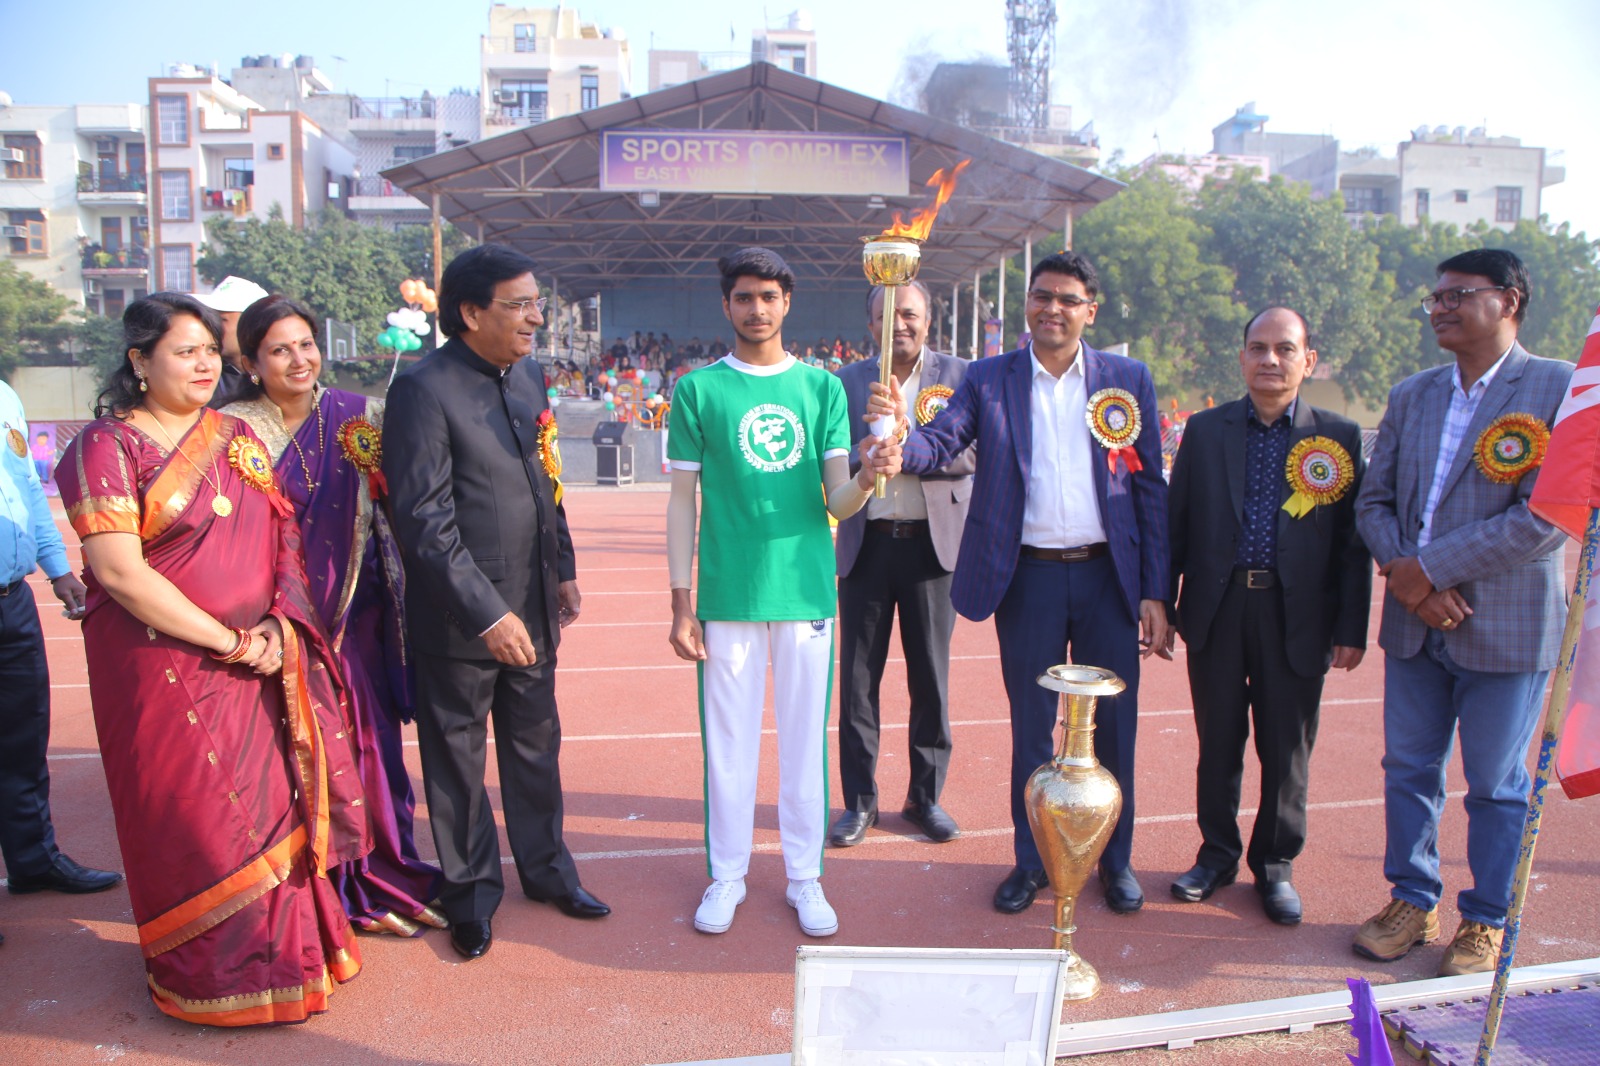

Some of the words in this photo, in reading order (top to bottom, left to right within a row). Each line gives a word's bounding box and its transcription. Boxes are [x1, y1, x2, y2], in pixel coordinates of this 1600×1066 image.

[622, 138, 739, 162] SPORTS
[748, 141, 887, 166] COMPLEX
[634, 166, 681, 180] EAST
[754, 403, 799, 421] INTERNATIONAL
[796, 422, 805, 449] SCHOOL
